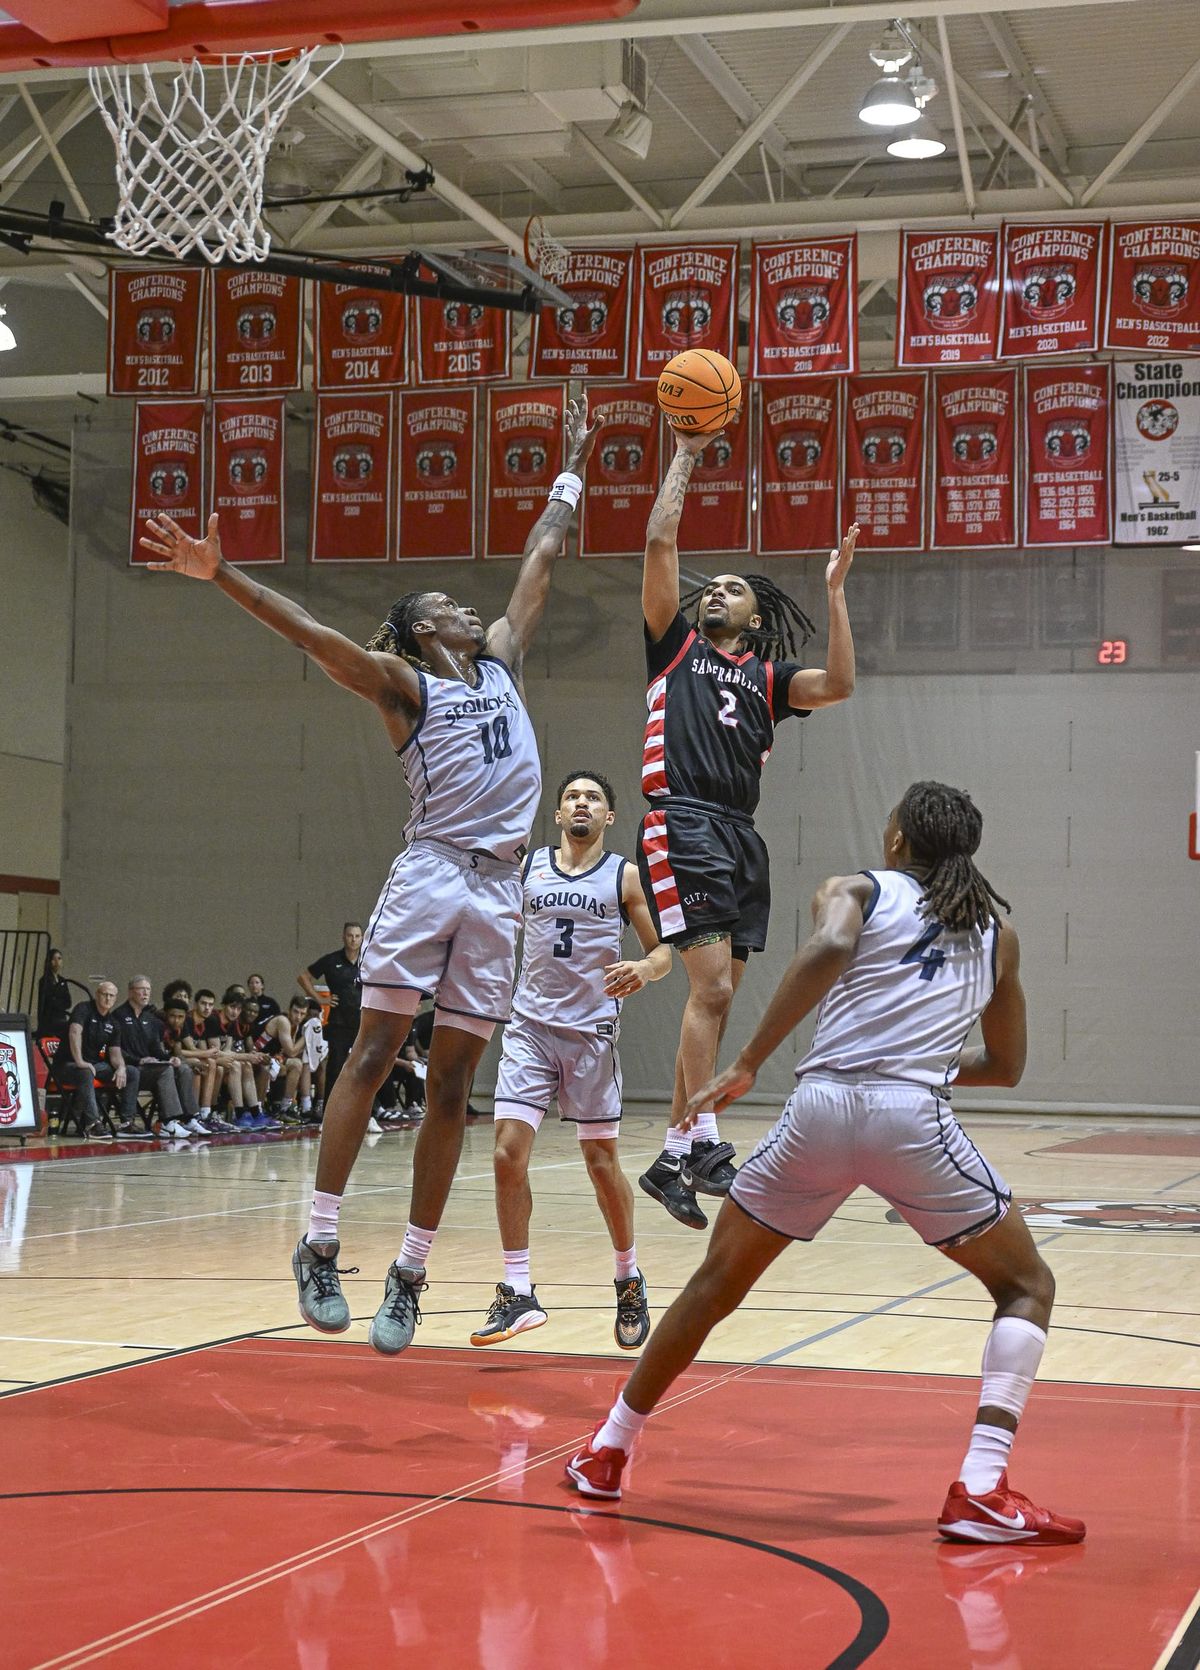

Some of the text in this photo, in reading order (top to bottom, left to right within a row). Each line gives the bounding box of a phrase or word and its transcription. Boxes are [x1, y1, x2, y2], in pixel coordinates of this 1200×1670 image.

[1011, 229, 1095, 251] CONFERENCE
[1119, 226, 1200, 246] CONFERENC
[911, 237, 992, 259] CONFERENCE
[1014, 244, 1089, 264] CHAMPIONS
[1123, 242, 1200, 259] CHAMPIONS
[546, 254, 625, 274] NFERENCE
[649, 252, 728, 276] CONFERENCE
[763, 248, 844, 272] CONFERENCE
[915, 252, 988, 271] CHAMPIONS
[227, 272, 287, 289] CONFERENCE
[653, 268, 722, 289] CHAMPIONS
[767, 264, 839, 284] CHAMPIONS
[128, 274, 187, 293] CONFERENCE
[231, 282, 283, 300] CHAMPIONS
[131, 287, 183, 302] CHAMPIONS
[1009, 320, 1088, 338] MEN'S BASKETBALL
[1116, 318, 1200, 333] MEN'S BASKETBALL
[453, 338, 494, 350] BASKETBALL
[910, 333, 991, 347] MEN'S BASKETBALL
[1037, 339, 1059, 350] 2020
[1147, 335, 1169, 347] 2022
[246, 351, 286, 361] BASKETBALL
[351, 346, 393, 357] BASKETBALL
[542, 349, 618, 360] MEN'S BASKETBALL
[764, 343, 842, 358] MEN'S BASKETBALL
[940, 350, 961, 361] 2019
[145, 355, 184, 365] BASKETBALL
[449, 353, 481, 372] 2015
[138, 369, 169, 386] 2012
[240, 365, 272, 383] 2013
[345, 360, 380, 379] 2014
[1134, 363, 1183, 380] State
[852, 391, 918, 409] CONFERENCE
[941, 387, 1008, 406] CONFERENCE
[1034, 382, 1102, 402] CONFERENCE
[495, 402, 558, 420] CONFERENCE
[592, 400, 655, 418] CONFERENCE
[767, 395, 833, 414] CONFERENCE
[856, 403, 914, 421] CHAMPIONS
[945, 400, 1005, 418] CHAMPIONS
[1038, 395, 1100, 414] CHAMPIONS
[220, 414, 278, 432] CONFERENCE
[324, 410, 384, 428] CONFERENCE
[407, 407, 468, 425] CONFERENCE
[500, 415, 554, 432] CHAMPIONS
[770, 408, 830, 425] CHAMPIONS
[142, 428, 199, 444] CONFERENCE
[222, 427, 275, 443] CHAMPIONS
[327, 423, 380, 439] CHAMPIONS
[410, 419, 464, 436] CHAMPIONS
[145, 441, 195, 455] CHAMPIONS
[871, 478, 916, 488] BASKETBALL
[962, 474, 1009, 486] BASKETBALL
[1055, 470, 1103, 482] BASKETBALL
[1159, 471, 1180, 481] 25-5
[609, 484, 654, 495] BASKETBALL
[786, 480, 833, 491] BASKETBALL
[238, 495, 278, 506] BASKETBALL
[342, 492, 383, 502] BASKETBALL
[425, 489, 467, 500] BASKETBALL
[1121, 511, 1196, 522] Men's Basketball
[1146, 526, 1168, 535] 1962
[1098, 640, 1127, 664] 23
[718, 690, 739, 728] 2
[476, 716, 513, 764] 10
[530, 892, 607, 920] SEQUOIAS
[684, 892, 708, 905] CITY
[553, 918, 575, 958] 3
[899, 922, 947, 982] 4
